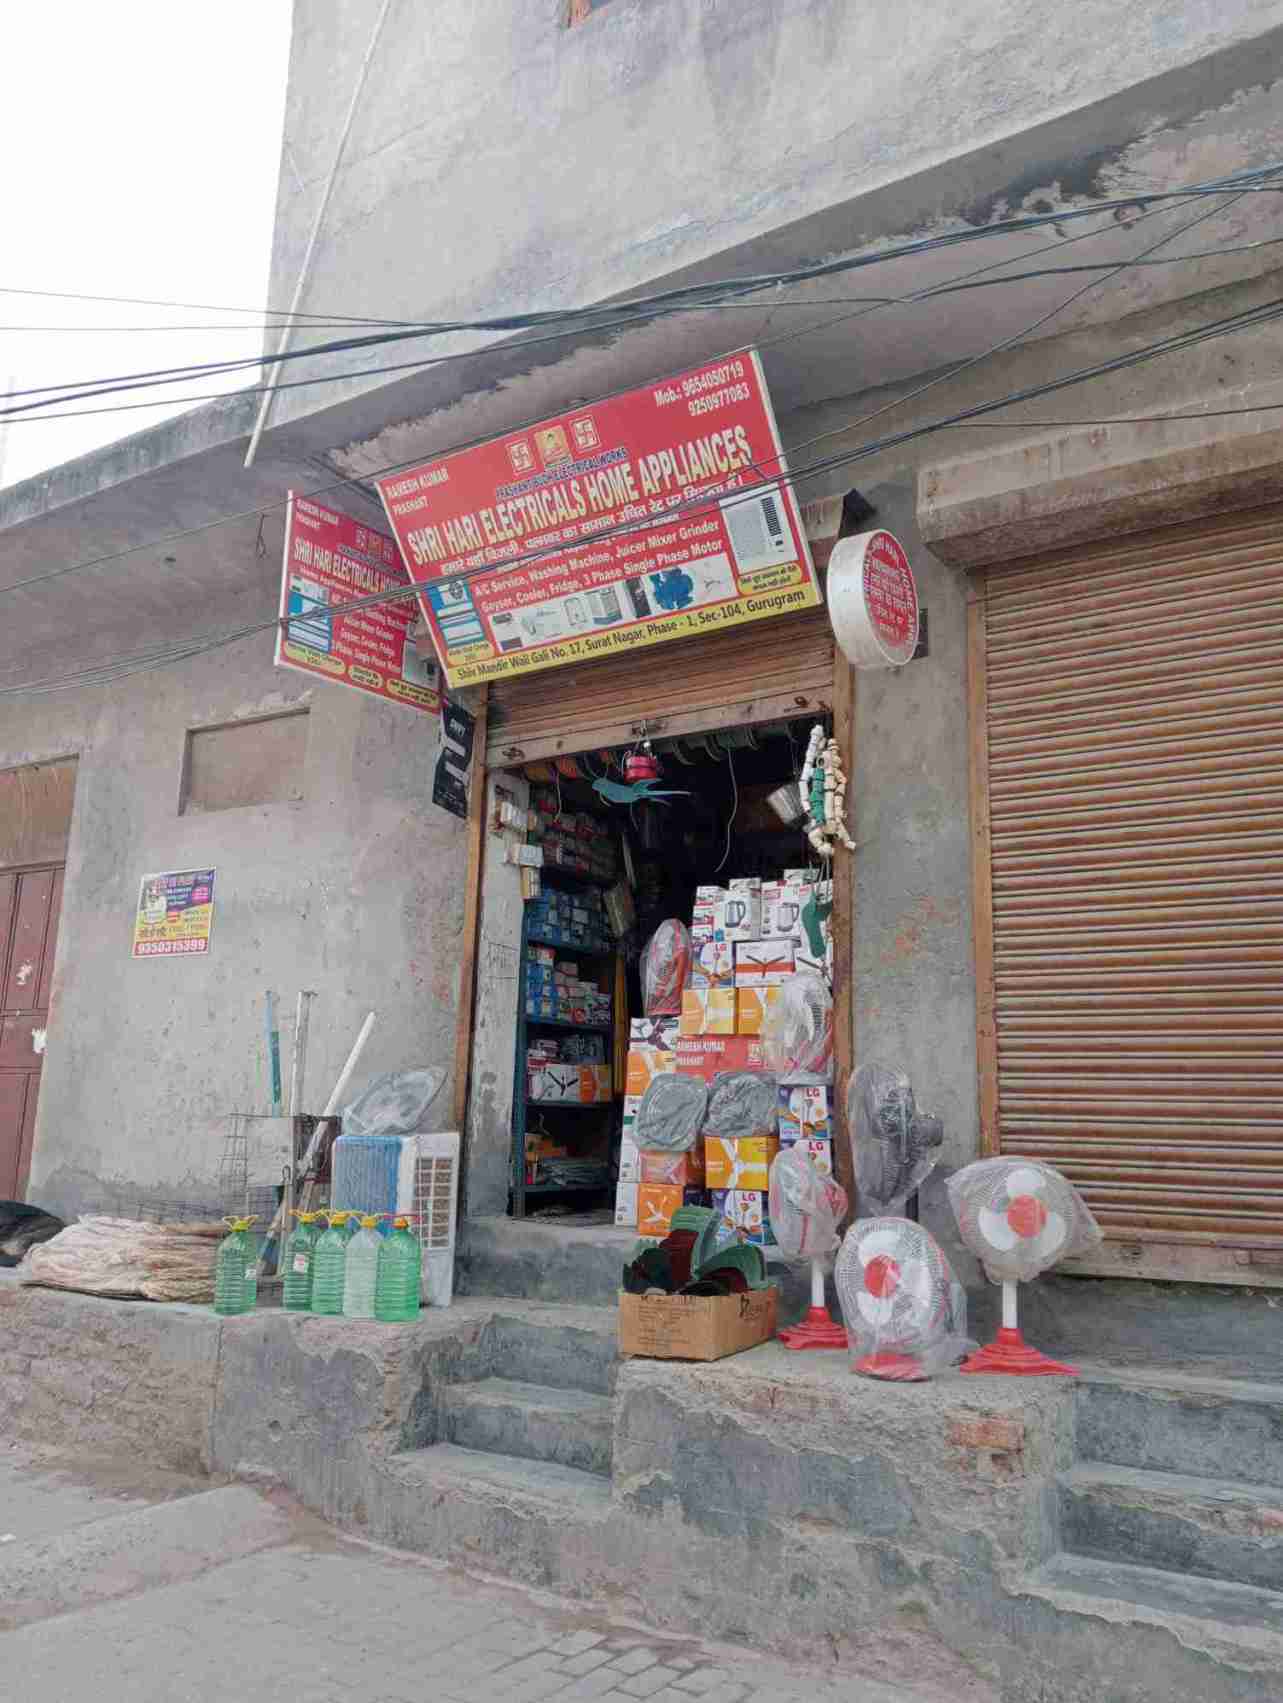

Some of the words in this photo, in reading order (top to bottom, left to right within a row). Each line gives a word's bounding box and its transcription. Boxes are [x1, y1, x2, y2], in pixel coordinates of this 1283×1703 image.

[420, 467, 448, 487] KUMAR
[407, 523, 448, 565] SHRI
[442, 513, 485, 555] HARI
[480, 479, 587, 544] ELECTRICALS
[585, 463, 639, 512] HOME
[638, 425, 753, 496] APPLIANCES
[680, 520, 719, 540] Grinder
[294, 536, 313, 566] SHRI
[313, 543, 332, 573] HARI
[657, 549, 689, 566] Phase
[690, 539, 722, 556] Motor
[585, 636, 611, 652] Surat
[647, 620, 677, 636] Phase
[698, 603, 745, 625] Sec-104,
[747, 590, 805, 613] Gurugram
[806, 1087, 820, 1097] LG
[808, 1141, 824, 1151] LG
[742, 1192, 756, 1201] LG
